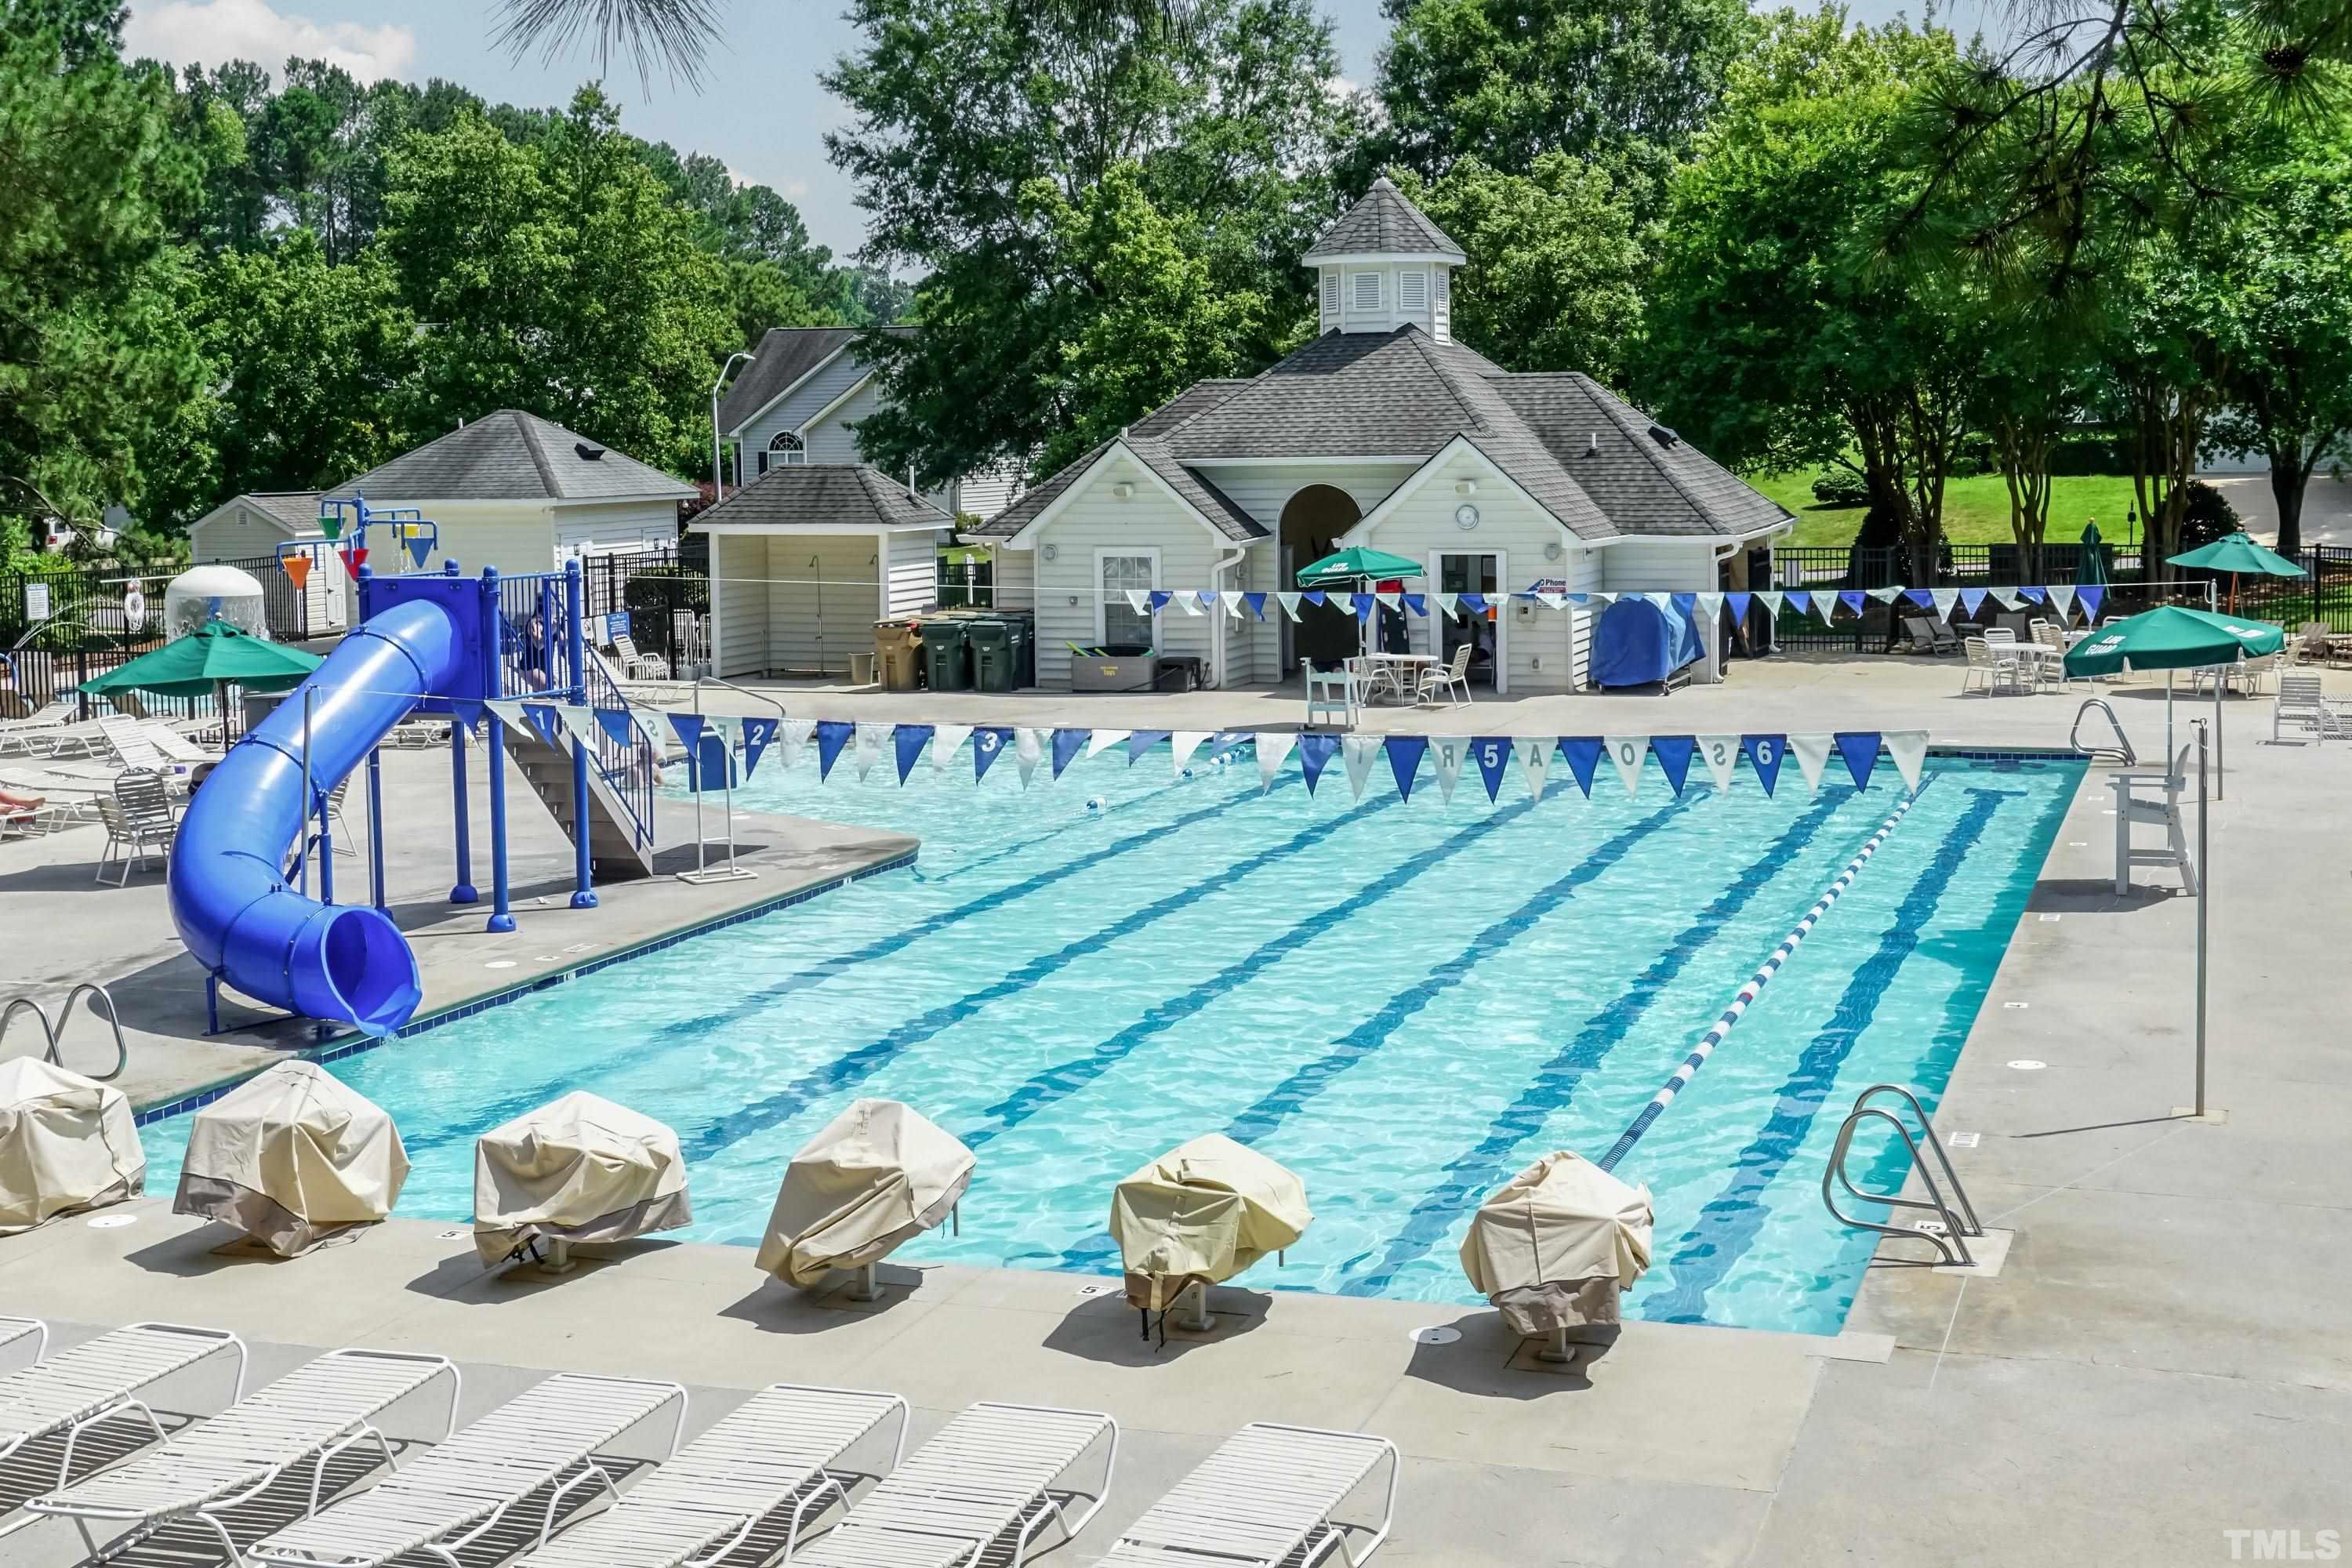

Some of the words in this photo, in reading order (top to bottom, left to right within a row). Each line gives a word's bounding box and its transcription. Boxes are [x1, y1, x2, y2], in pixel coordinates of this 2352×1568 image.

[535, 710, 546, 730] 1
[750, 724, 764, 745] 2
[982, 732, 998, 752] 3
[1484, 744, 1498, 768] 5
[1530, 745, 1543, 768] A
[1757, 741, 1773, 764] 6
